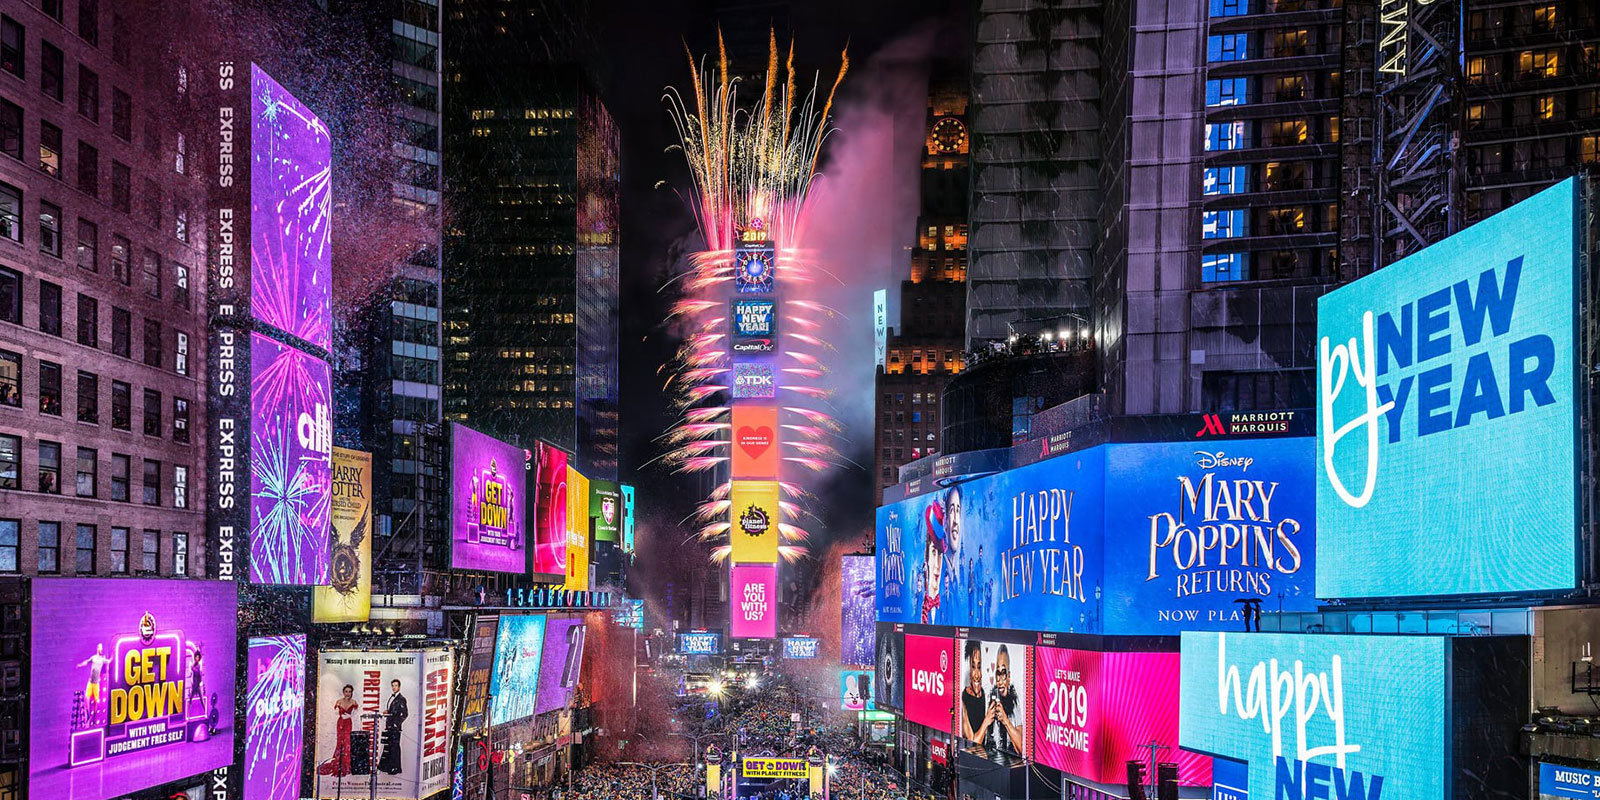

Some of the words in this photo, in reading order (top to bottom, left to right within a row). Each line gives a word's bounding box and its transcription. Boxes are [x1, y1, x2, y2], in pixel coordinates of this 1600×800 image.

[1378, 0, 1407, 76] AM
[219, 61, 233, 90] SS
[219, 107, 234, 188] EXPRESS
[219, 208, 234, 289] EXPRESS
[743, 231, 767, 241] 2019
[736, 304, 773, 315] HAPPY
[741, 314, 768, 323] NEW
[876, 303, 885, 337] NEW
[1377, 254, 1525, 377] NEW
[219, 304, 234, 397] EPRESS
[743, 375, 773, 385] TDK
[1375, 333, 1557, 445] YEAR
[1231, 411, 1295, 423] MARRIOTT
[1231, 422, 1287, 433] MARQUIS
[219, 418, 234, 509] EXPRESS
[331, 462, 364, 484] HARRY
[331, 481, 366, 499] OTTER
[485, 480, 503, 506] GET
[1176, 472, 1279, 527] MARY
[480, 501, 507, 529] DOWN
[741, 518, 763, 527] planet
[1012, 488, 1075, 550] HAPPY
[1145, 511, 1302, 582] POPPINS
[743, 583, 766, 593] ARE
[1001, 548, 1037, 603] NEW
[1039, 545, 1086, 603] YEAR
[1176, 569, 1272, 598] RETURNS
[506, 587, 544, 607] 1540
[547, 587, 613, 607] BROADWAY
[740, 602, 768, 612] WITH
[743, 592, 766, 602] YOU
[744, 611, 764, 621] US?
[1157, 610, 1200, 622] NOW
[124, 646, 171, 686] GET
[1054, 668, 1067, 680] LET'S
[1067, 670, 1081, 682] MAKE
[110, 680, 184, 725] DOWN
[362, 670, 381, 713] PRETTY
[467, 682, 488, 700] FRM
[1048, 681, 1088, 728] 2019
[423, 670, 438, 758] WOMAN
[435, 667, 449, 755] PRETTY
[1217, 631, 1361, 795] happy
[108, 737, 150, 755] JUDGEMENT
[151, 734, 168, 746] FREE
[168, 729, 184, 741] SELF
[129, 726, 147, 739] WITH
[148, 722, 166, 735] YOUR
[1045, 723, 1089, 753] AWESOME
[745, 760, 766, 771] GET
[1275, 755, 1385, 800] NEW
[1555, 770, 1591, 786] MUSIC
